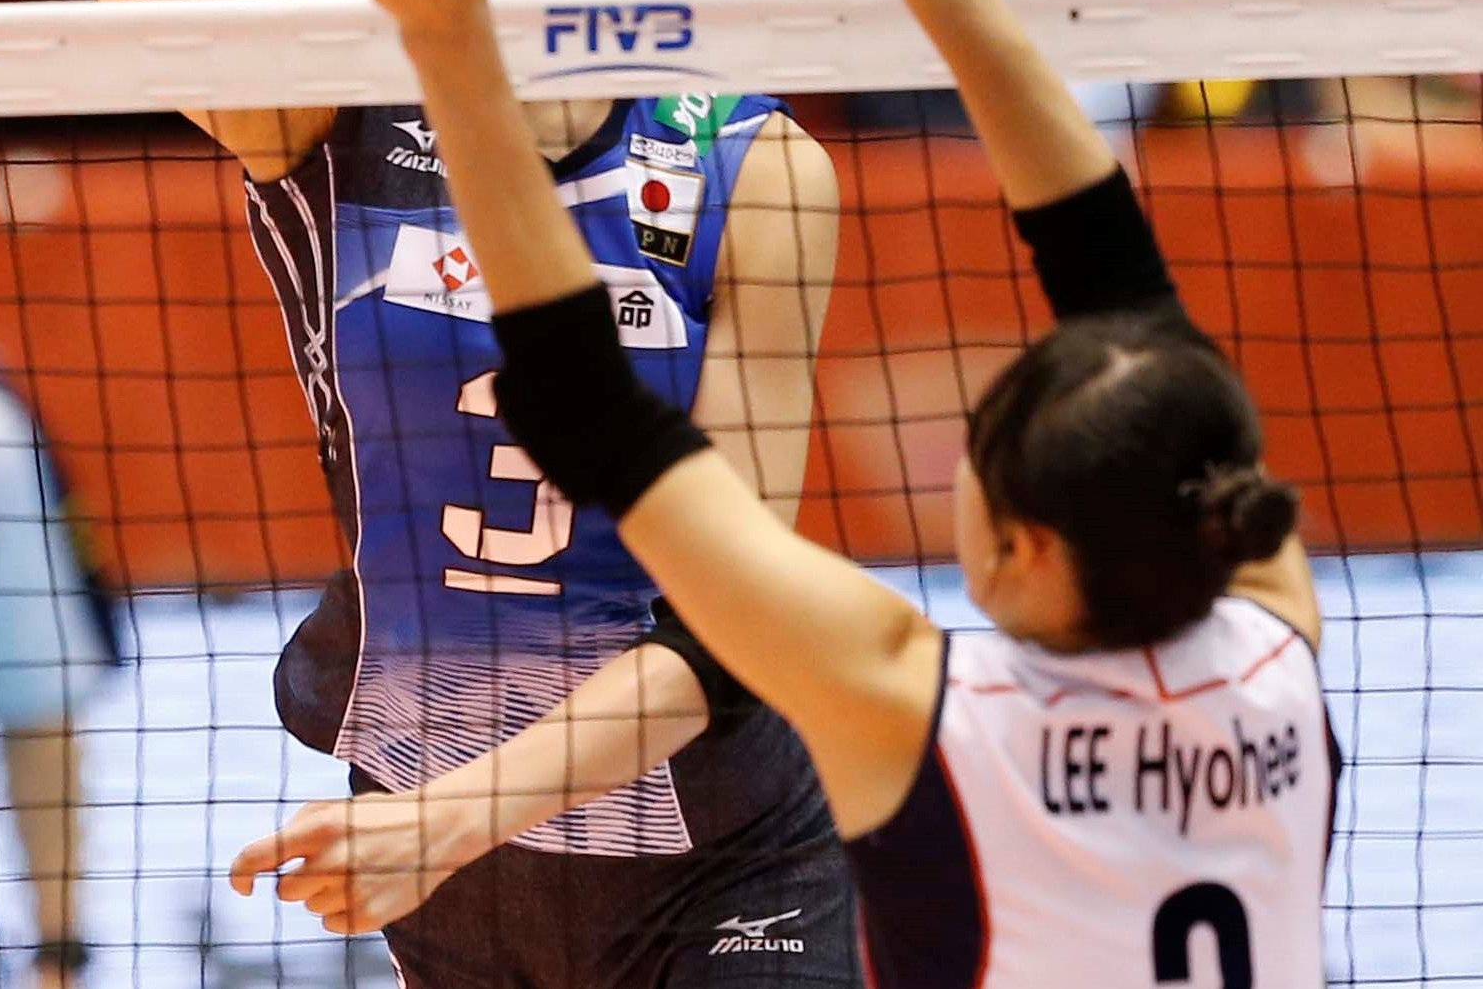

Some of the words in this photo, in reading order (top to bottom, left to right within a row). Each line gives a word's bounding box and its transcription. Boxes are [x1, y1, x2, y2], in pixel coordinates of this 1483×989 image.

[546, 3, 693, 52] FIVB
[424, 291, 472, 311] NISSAY
[1040, 726, 1114, 814] LEE
[1134, 716, 1298, 837] Hyohee
[708, 936, 805, 955] MIZUNO
